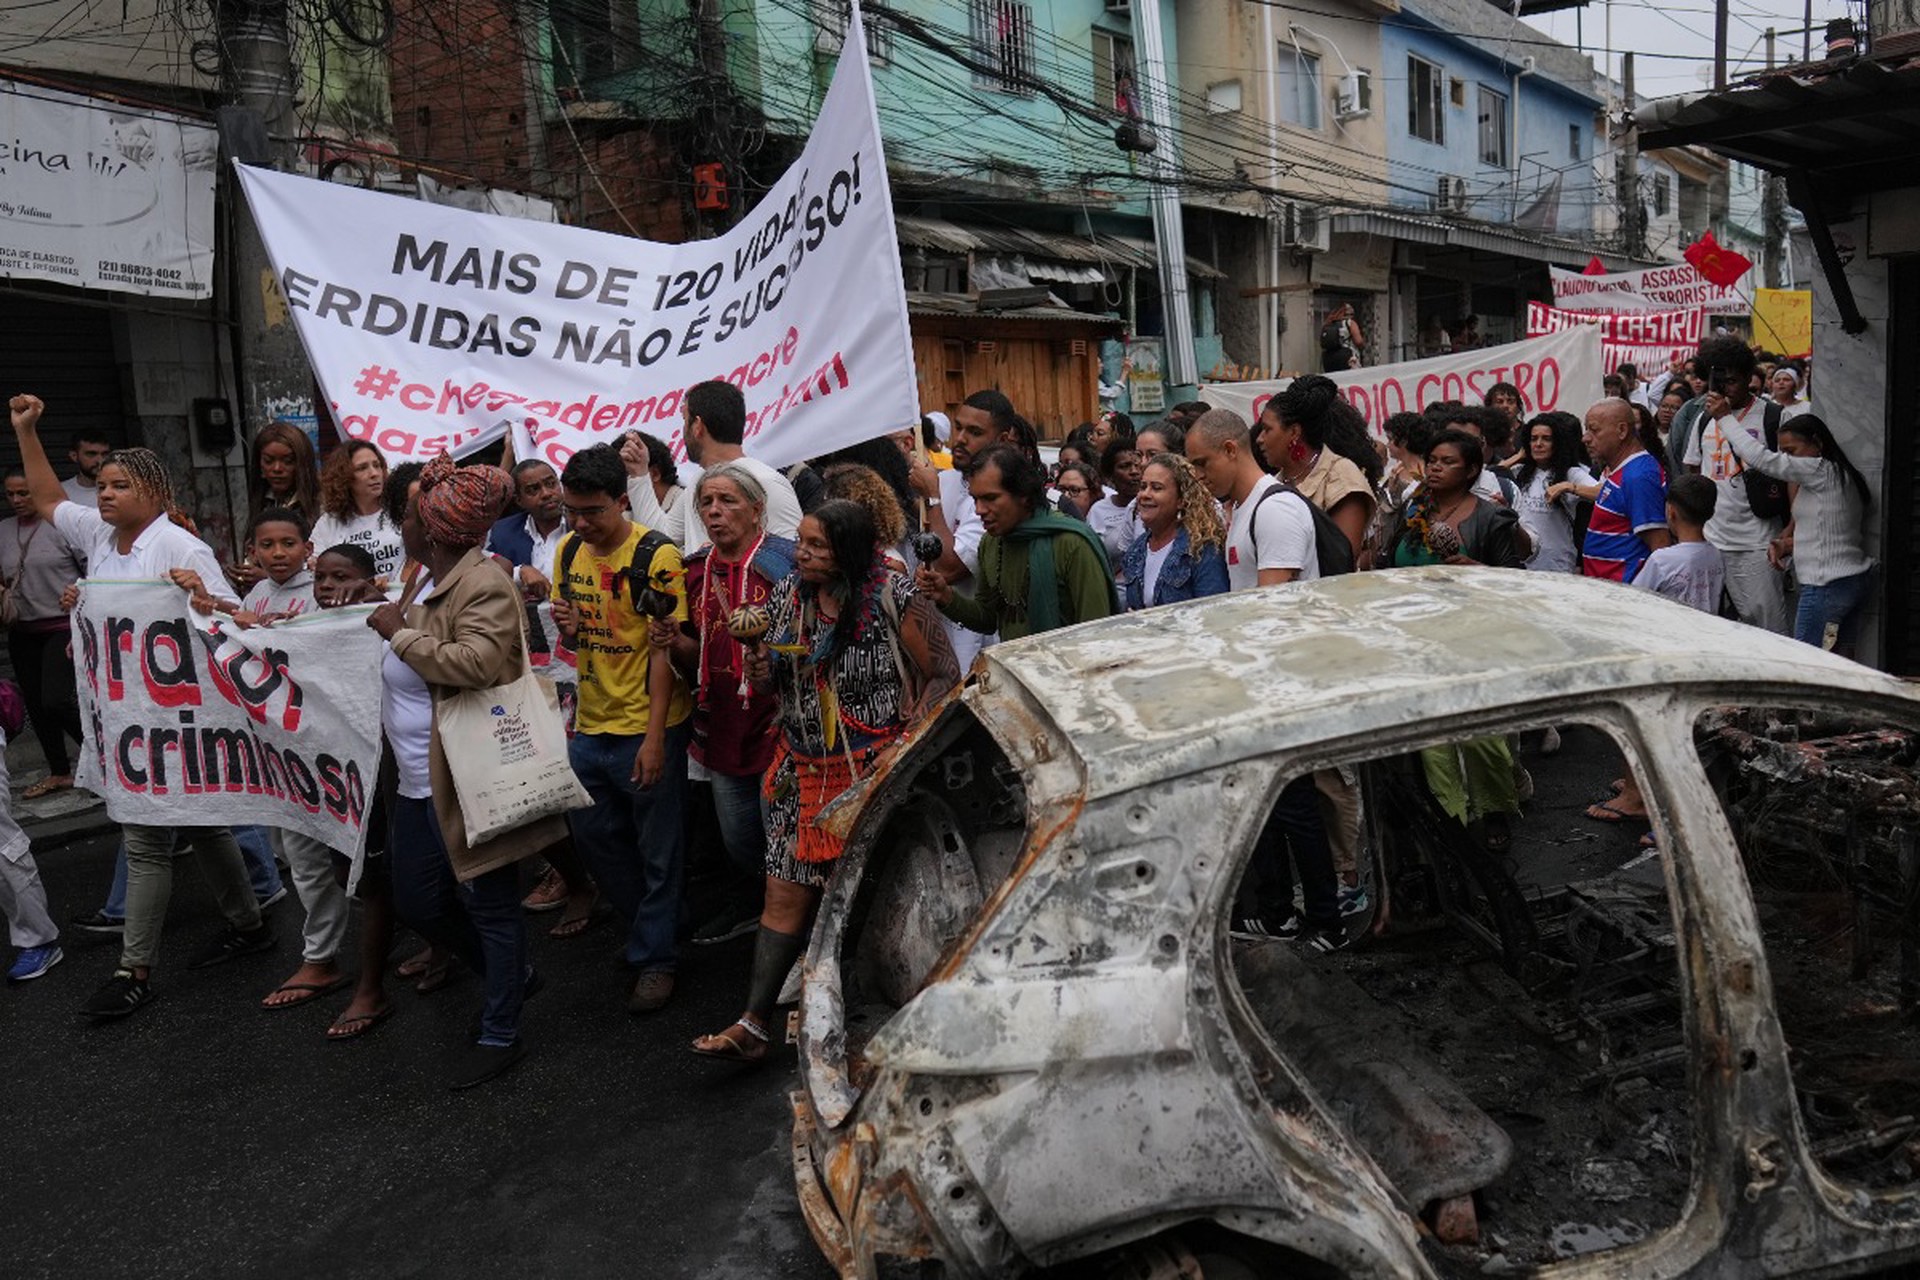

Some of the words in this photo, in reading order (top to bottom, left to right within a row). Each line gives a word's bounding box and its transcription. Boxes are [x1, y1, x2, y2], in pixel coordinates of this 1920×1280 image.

[391, 233, 542, 295] MAIS
[555, 260, 639, 308] DE
[652, 262, 724, 311] 120
[1641, 266, 1708, 290] ASSASSI
[553, 318, 673, 368] NÃO
[678, 305, 711, 357] É
[1617, 306, 1700, 343] CASTRO
